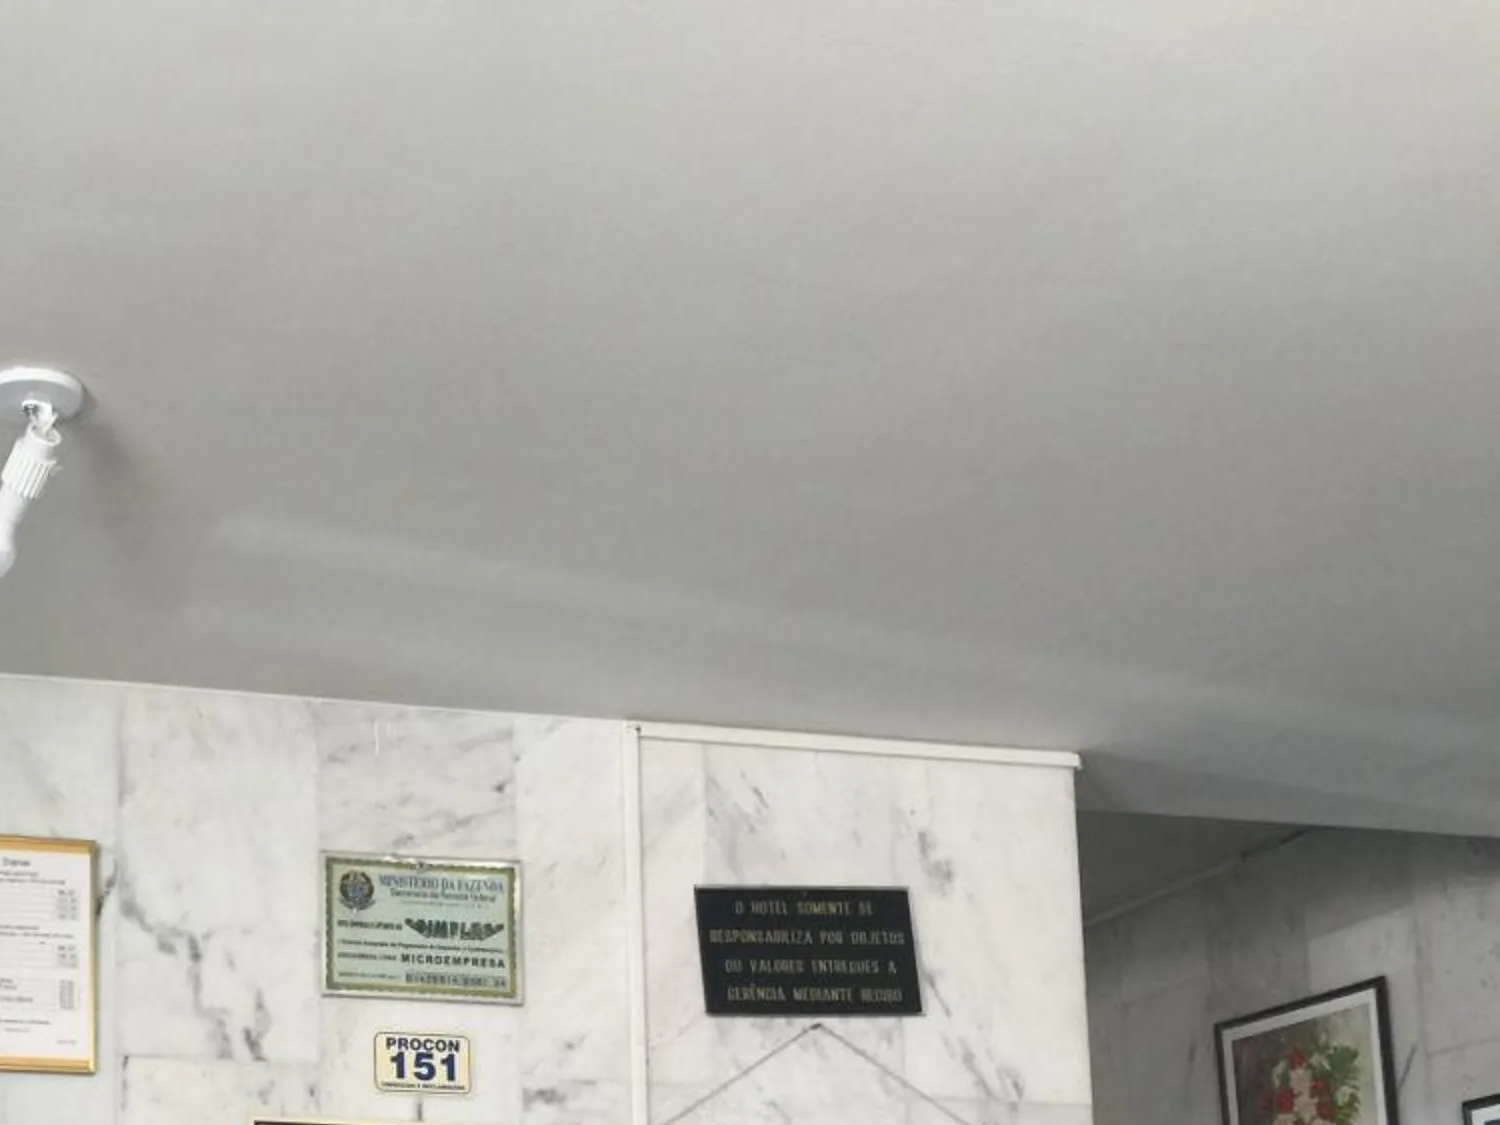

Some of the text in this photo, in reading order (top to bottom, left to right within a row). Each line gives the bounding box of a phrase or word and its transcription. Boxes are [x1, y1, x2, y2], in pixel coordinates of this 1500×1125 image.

[751, 901, 788, 916] HOTEL
[797, 901, 850, 916] SOMENTE
[851, 931, 905, 945] OBJETOS
[401, 951, 506, 969] MICROEMPRESA
[725, 959, 742, 973] OU
[749, 959, 804, 974] VALORES
[386, 1036, 460, 1053] PROCON
[389, 1051, 456, 1082] 151
